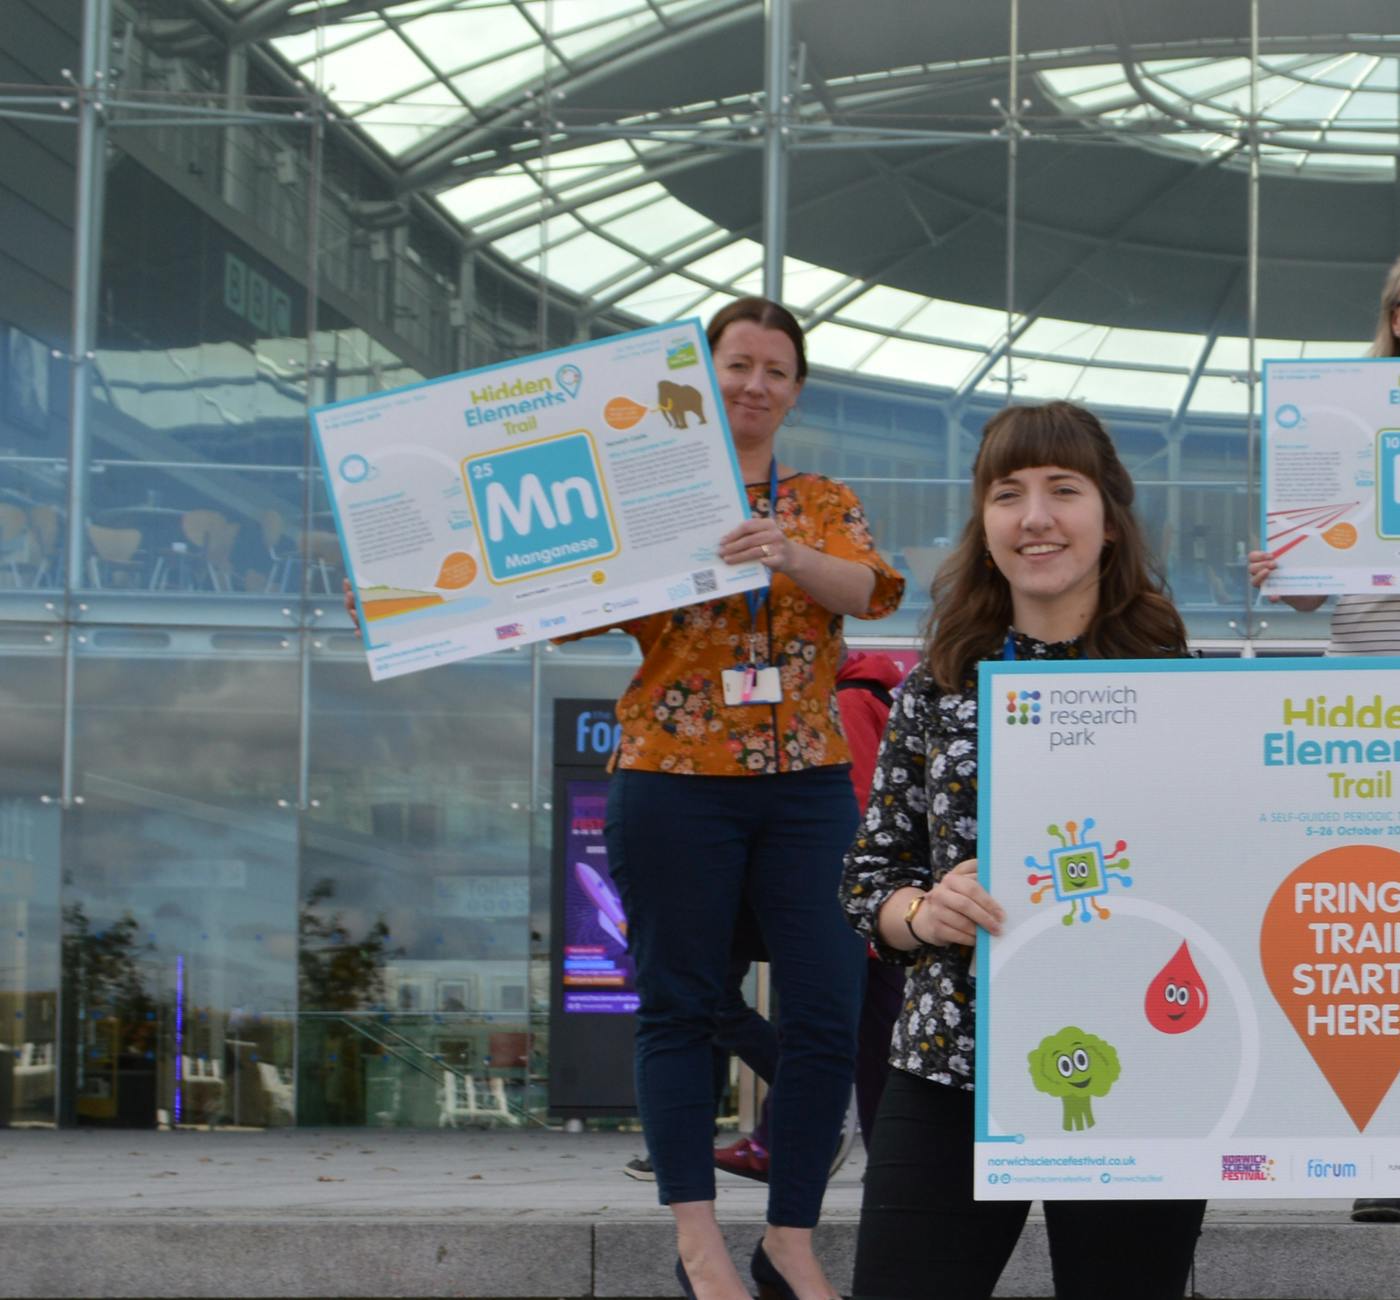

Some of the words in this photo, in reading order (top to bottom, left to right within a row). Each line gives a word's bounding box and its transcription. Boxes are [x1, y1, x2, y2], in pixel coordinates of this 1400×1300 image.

[470, 377, 552, 405] Hidden
[464, 391, 566, 427] Elements
[503, 416, 538, 435] Trail
[1385, 437, 1400, 448] 10
[472, 463, 493, 479] 25
[486, 473, 599, 542] Mn
[505, 537, 600, 569] Manganese
[1050, 685, 1137, 704] norwich
[1050, 706, 1137, 725] research
[1050, 727, 1096, 752] park
[1327, 770, 1393, 799] Trail
[1259, 812, 1268, 823] A
[1271, 812, 1341, 823] SELF-GUIDED
[1343, 811, 1394, 822] PERIODIC
[1337, 825, 1384, 836] October
[988, 1155, 1137, 1167] norwichsciencefestival.co.uk
[1222, 1155, 1267, 1164] NORWICH
[1222, 1163, 1261, 1172] SCIENCE
[1307, 1159, 1357, 1178] forum
[1222, 1172, 1268, 1181] FESTIVAL
